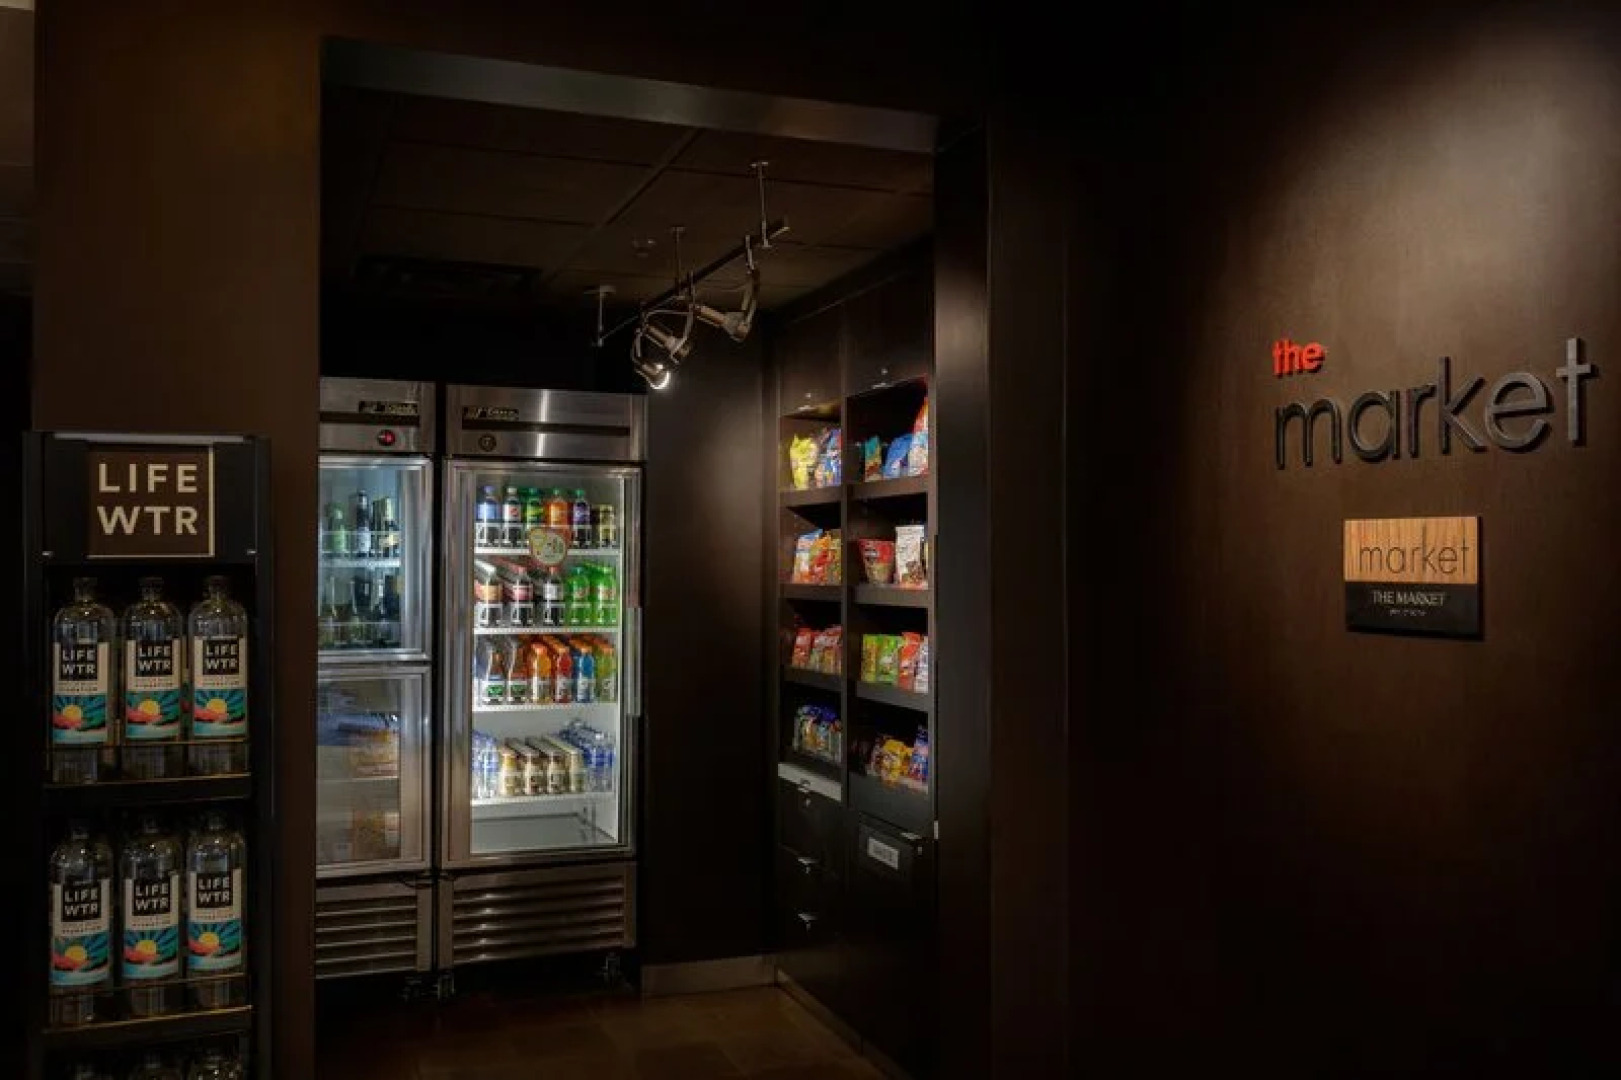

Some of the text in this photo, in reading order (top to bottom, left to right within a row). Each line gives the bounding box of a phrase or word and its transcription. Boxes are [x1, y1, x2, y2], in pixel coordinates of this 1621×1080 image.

[1272, 340, 1324, 377] the
[1275, 338, 1597, 469] market
[98, 463, 198, 493] LIFE
[96, 505, 198, 536] WTR
[1359, 526, 1470, 575] market
[1372, 590, 1445, 606] THE MARKET
[62, 649, 96, 662] LIFE
[139, 645, 171, 657] LIFE
[206, 643, 238, 657] LIFE
[62, 662, 96, 675] WTR
[139, 657, 171, 672] WTR
[206, 657, 238, 671] WTR
[135, 882, 169, 898] LIFE
[198, 876, 230, 890] LIFE
[64, 887, 98, 903] LIFE
[200, 889, 230, 904] WTR
[64, 902, 98, 916] WTR
[135, 897, 169, 912] WTR
